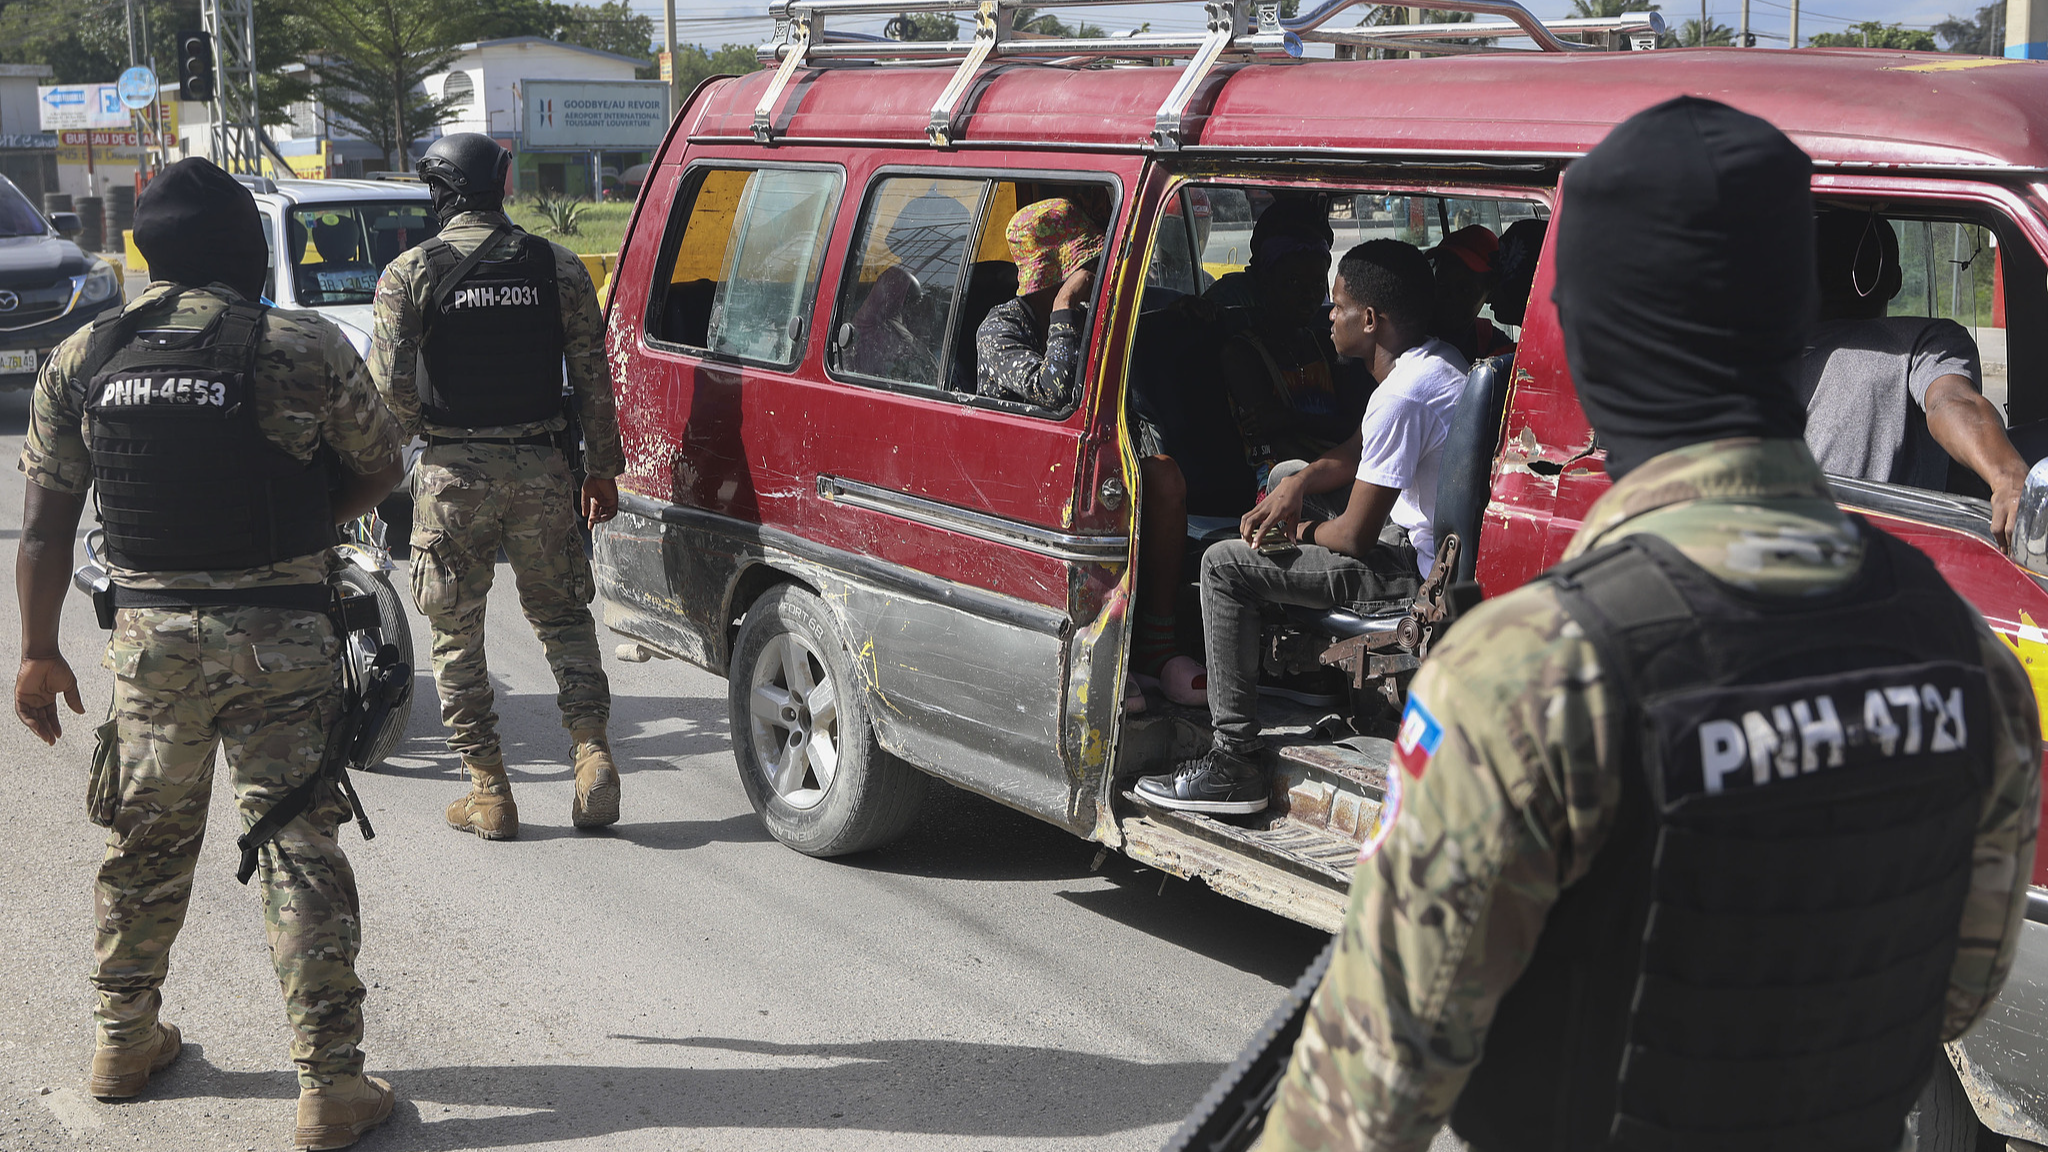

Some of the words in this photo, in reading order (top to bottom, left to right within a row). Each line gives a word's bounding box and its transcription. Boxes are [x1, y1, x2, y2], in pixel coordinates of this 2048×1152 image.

[564, 100, 625, 110] GOODBYE/AU
[628, 101, 660, 110] REVOIR
[604, 112, 661, 121] INTERNATIONAL
[66, 133, 109, 145] BUREAU
[112, 134, 126, 145] DE
[455, 286, 539, 309] PNH-2031
[101, 378, 226, 407] PNH-4553
